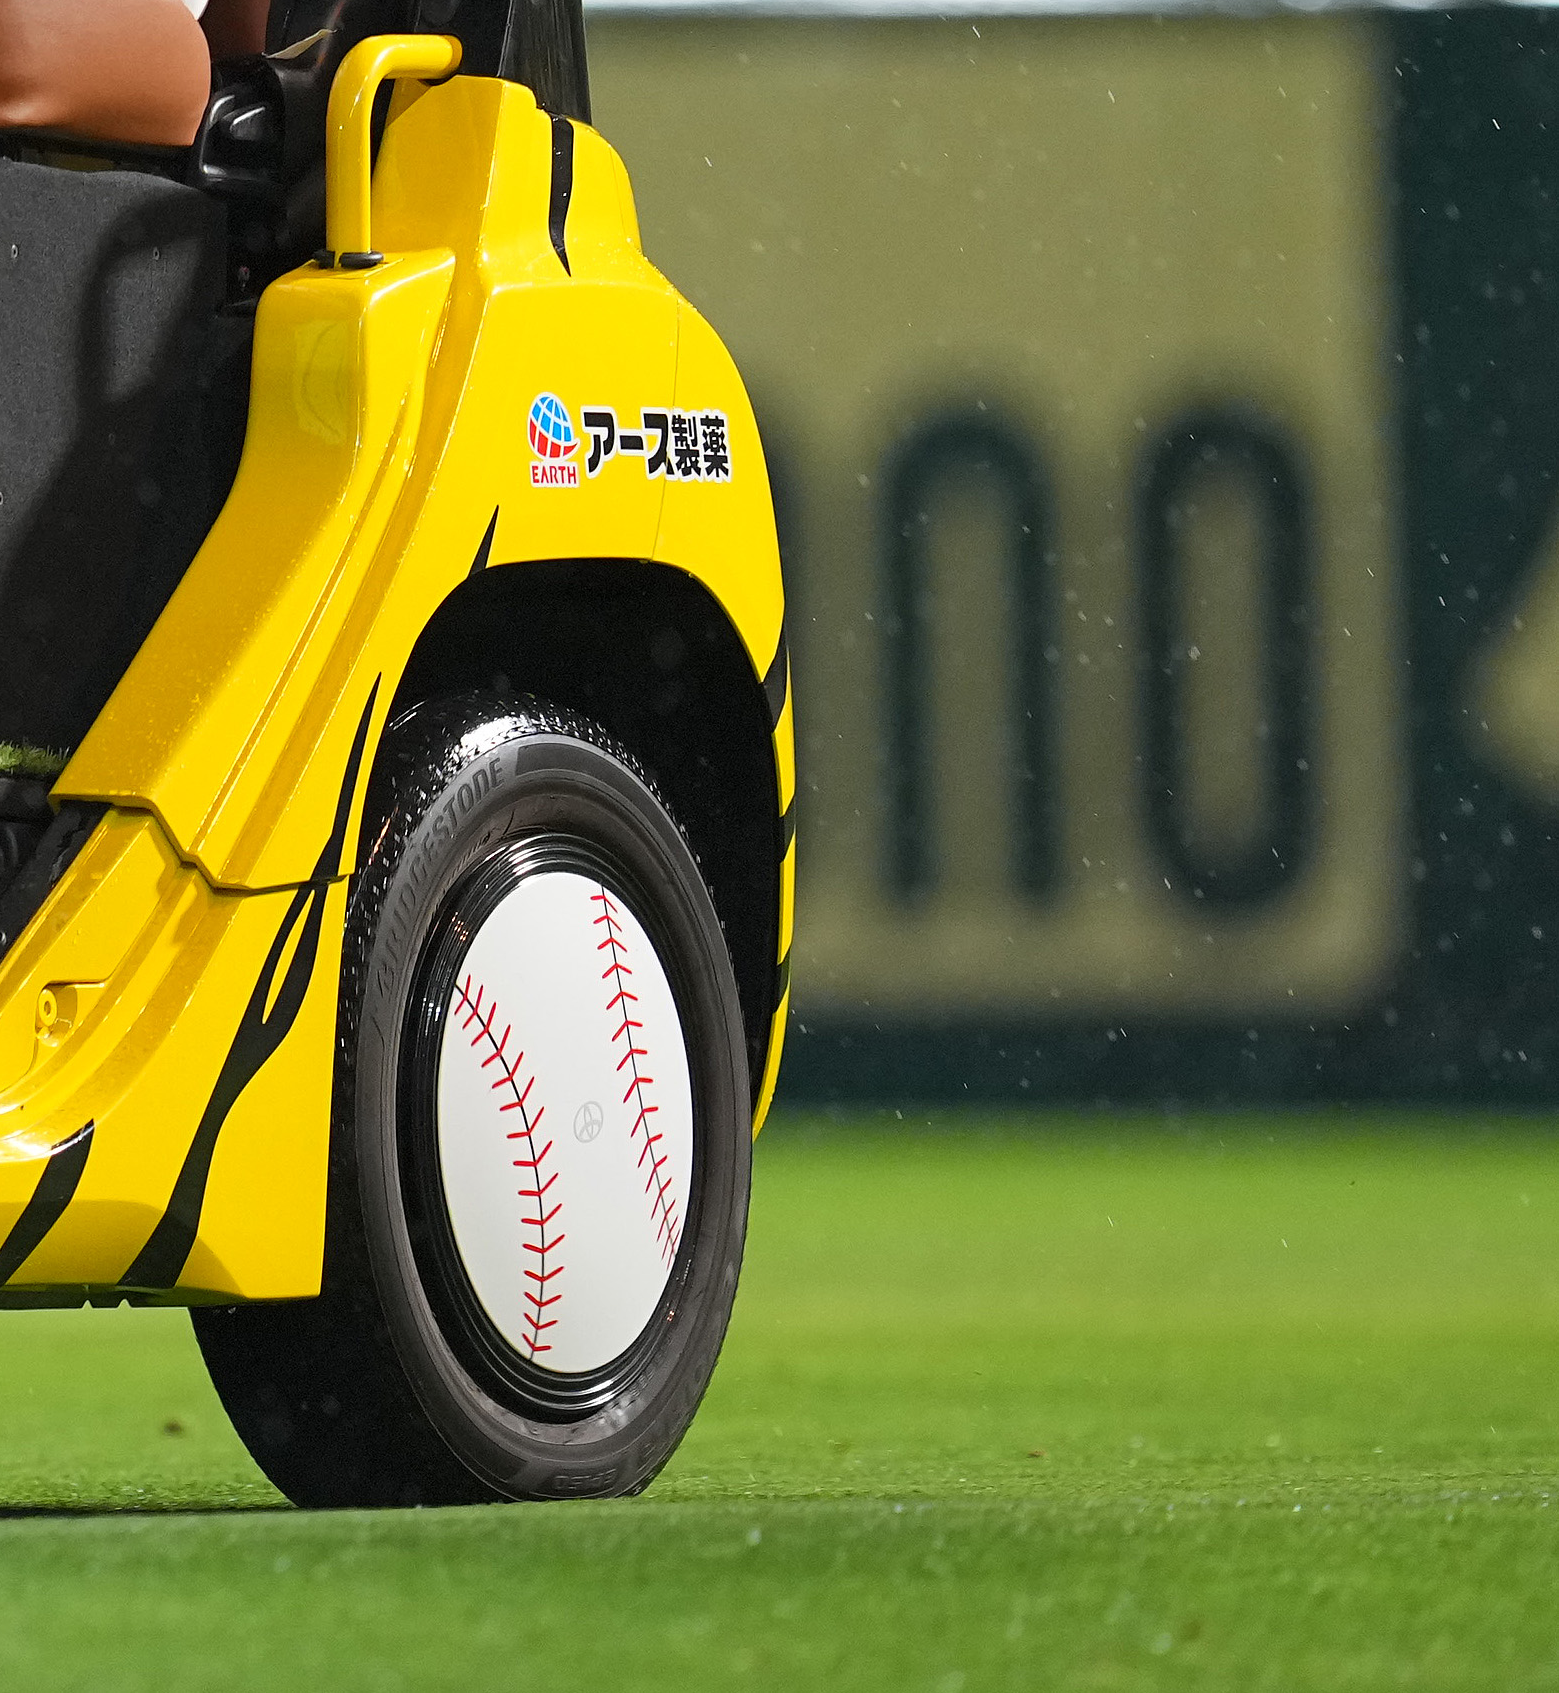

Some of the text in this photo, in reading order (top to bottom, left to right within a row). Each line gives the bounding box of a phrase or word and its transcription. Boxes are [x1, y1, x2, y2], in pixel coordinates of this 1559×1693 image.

[583, 411, 729, 478] アース製薬
[531, 465, 577, 485] EARTH
